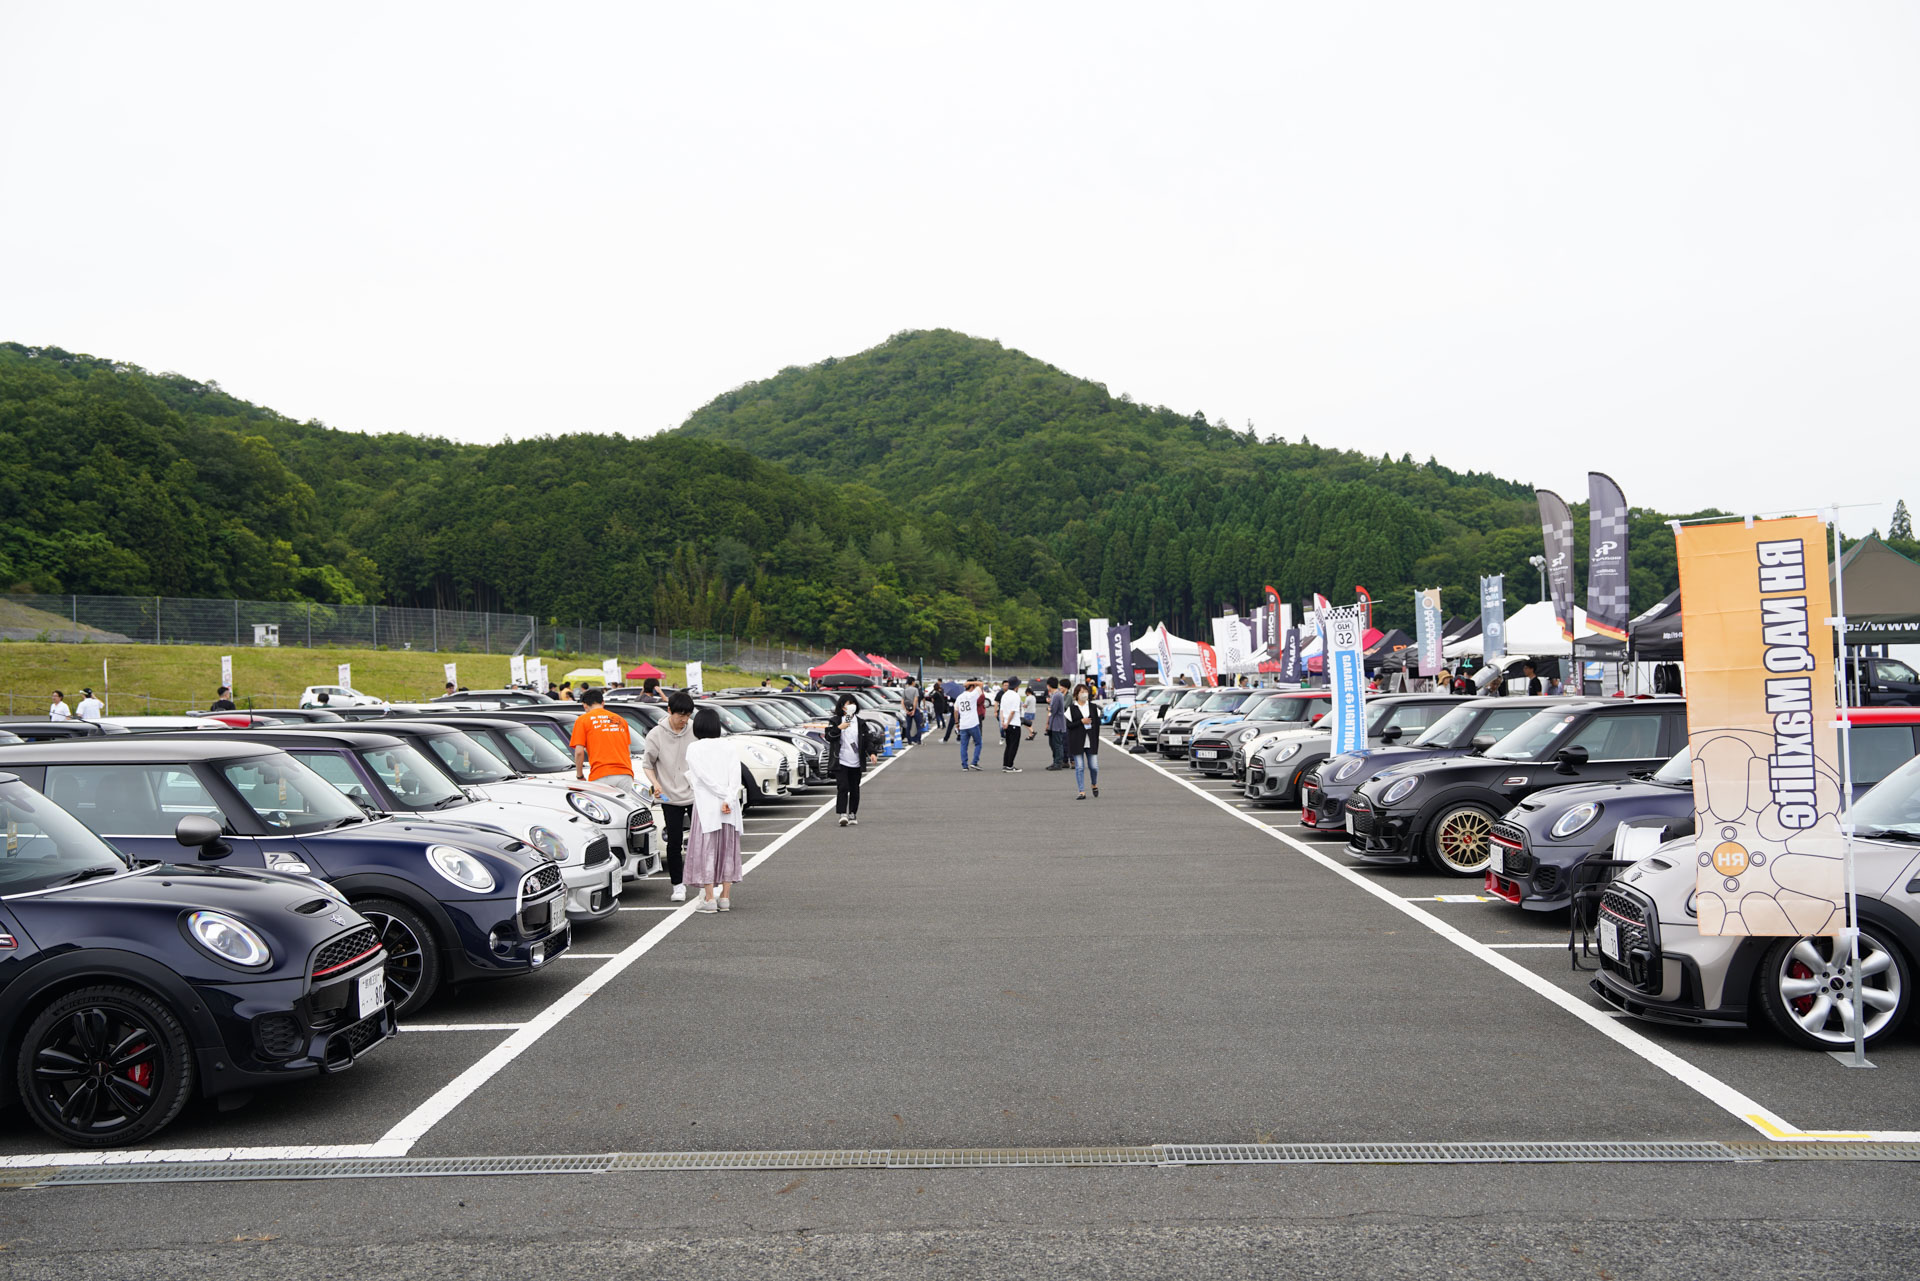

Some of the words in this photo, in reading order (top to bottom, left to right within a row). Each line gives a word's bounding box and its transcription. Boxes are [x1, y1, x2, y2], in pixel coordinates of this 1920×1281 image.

[1338, 632, 1353, 645] 32
[1342, 654, 1354, 692] GARAGE
[959, 700, 972, 712] 32
[1343, 704, 1356, 753] LIGHTHOU
[269, 854, 280, 864] 7
